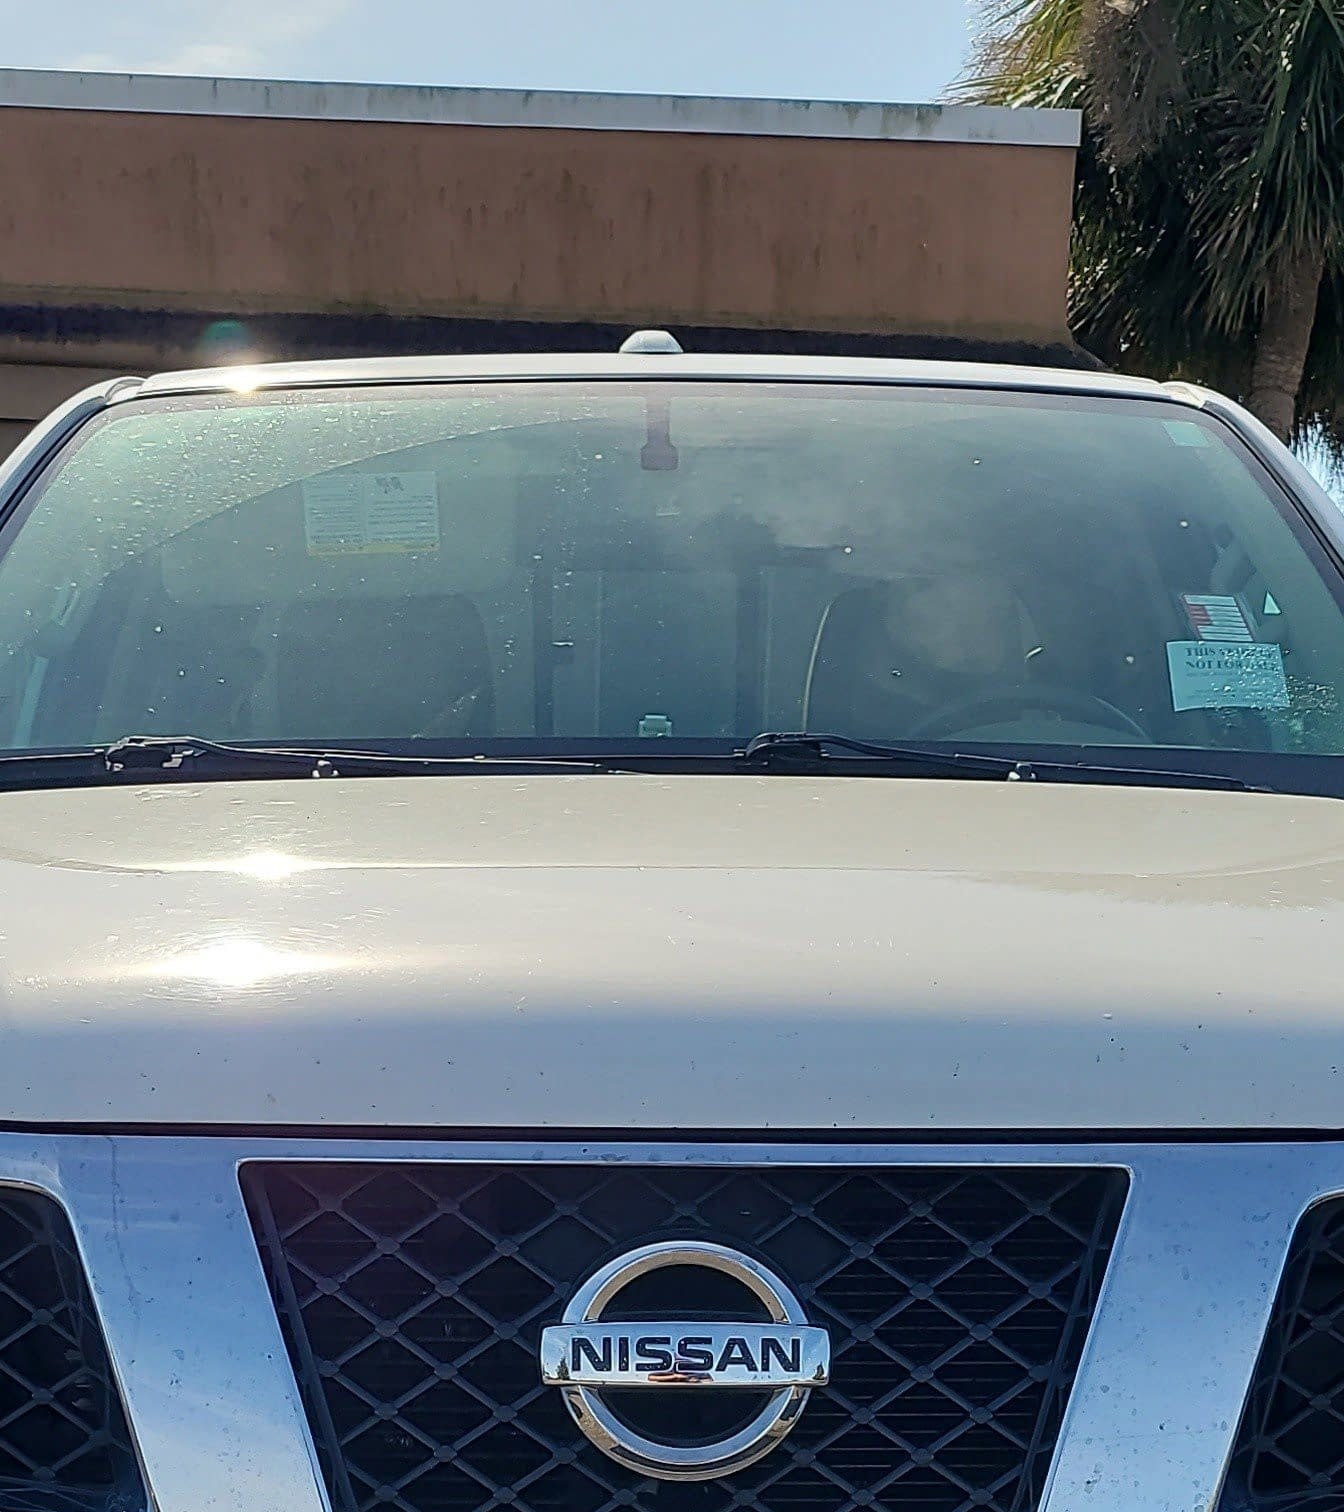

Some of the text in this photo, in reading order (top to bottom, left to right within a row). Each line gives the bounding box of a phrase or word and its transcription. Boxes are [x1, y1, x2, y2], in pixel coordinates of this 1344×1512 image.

[1185, 647, 1216, 657] THIS
[1185, 660, 1212, 669] NOT
[570, 1336, 802, 1373] NISSAN
